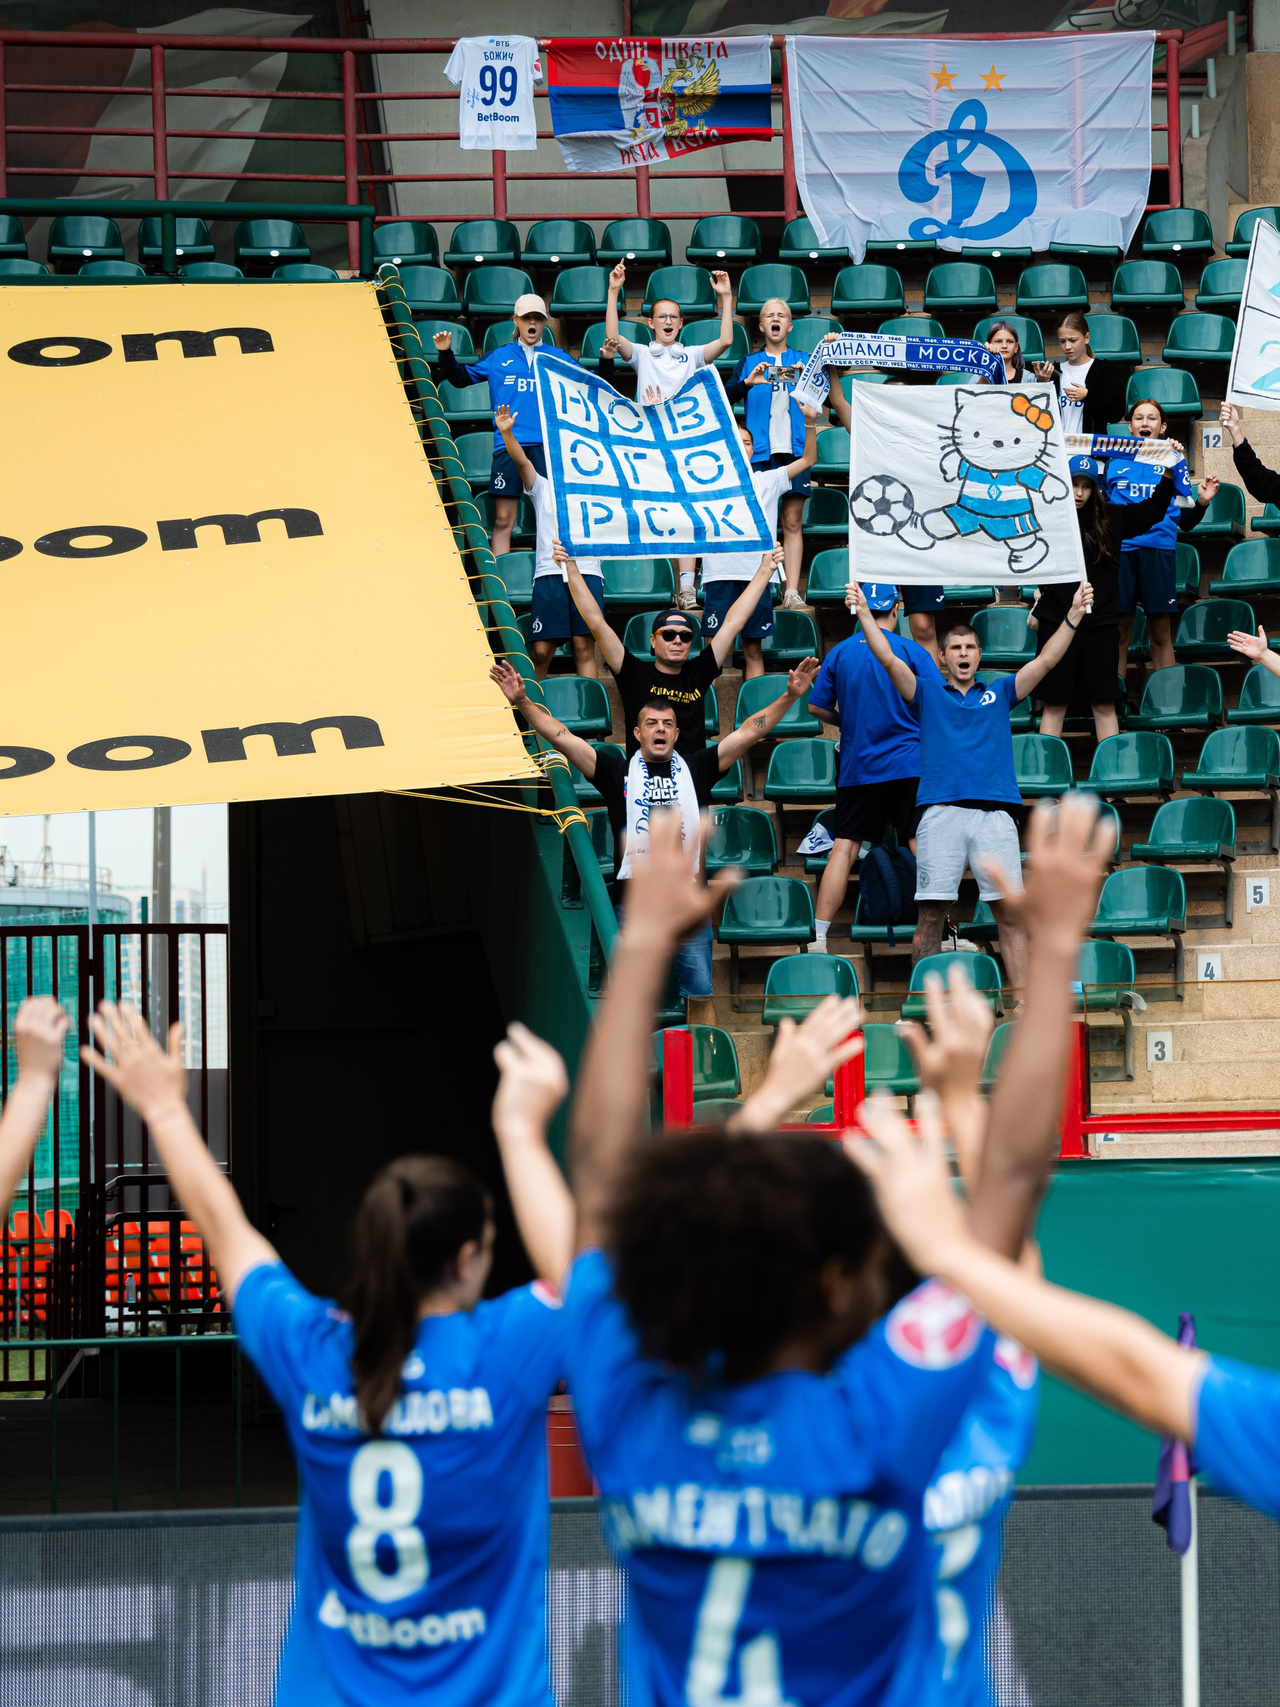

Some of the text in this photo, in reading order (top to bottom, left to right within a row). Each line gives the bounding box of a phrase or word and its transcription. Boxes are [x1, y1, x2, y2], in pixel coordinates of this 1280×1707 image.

[484, 51, 513, 61] БОЖИЧ
[595, 41, 729, 62] ОДНИ ЦВЕТА
[479, 65, 518, 107] 99
[477, 112, 520, 122] BetBoom
[672, 129, 723, 151] ВЕРА
[822, 342, 998, 375] ДИНАМО МОСКВА
[518, 378, 536, 392] ВТ
[1094, 436, 1172, 461] ДИНАМО
[1204, 434, 1220, 448] 12
[0, 508, 324, 562] om
[871, 584, 877, 598] 1
[1253, 886, 1263, 904] 5
[1204, 962, 1215, 980] 4
[1155, 1041, 1165, 1061] 3
[347, 1439, 430, 1603] 8
